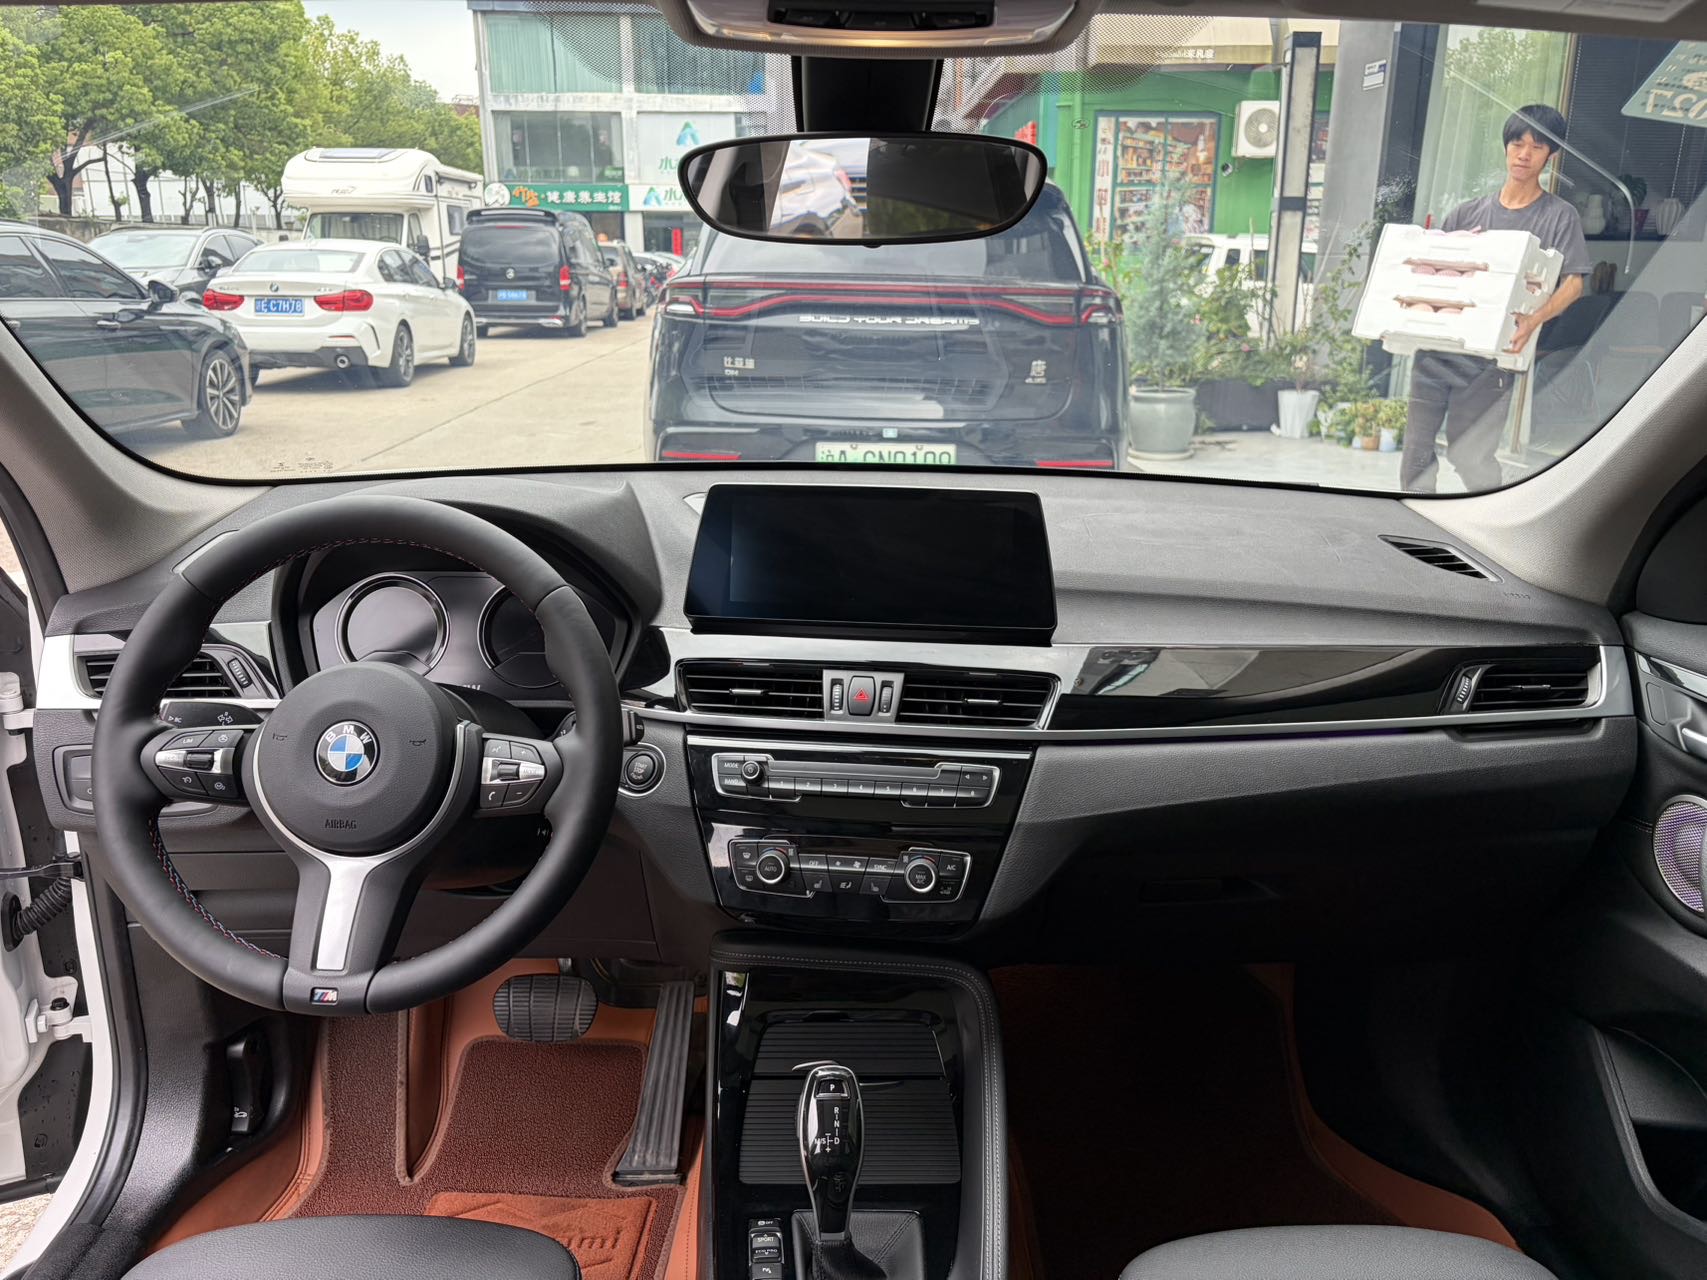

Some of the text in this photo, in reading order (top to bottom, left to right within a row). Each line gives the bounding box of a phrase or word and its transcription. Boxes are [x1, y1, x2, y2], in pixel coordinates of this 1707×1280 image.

[799, 314, 980, 325] BUILD YOUR DREAMS
[325, 725, 372, 744] BMW
[325, 819, 357, 829] AIRBAG
[829, 1084, 835, 1092] P
[834, 1106, 840, 1114] R
[834, 1137, 840, 1145] D
